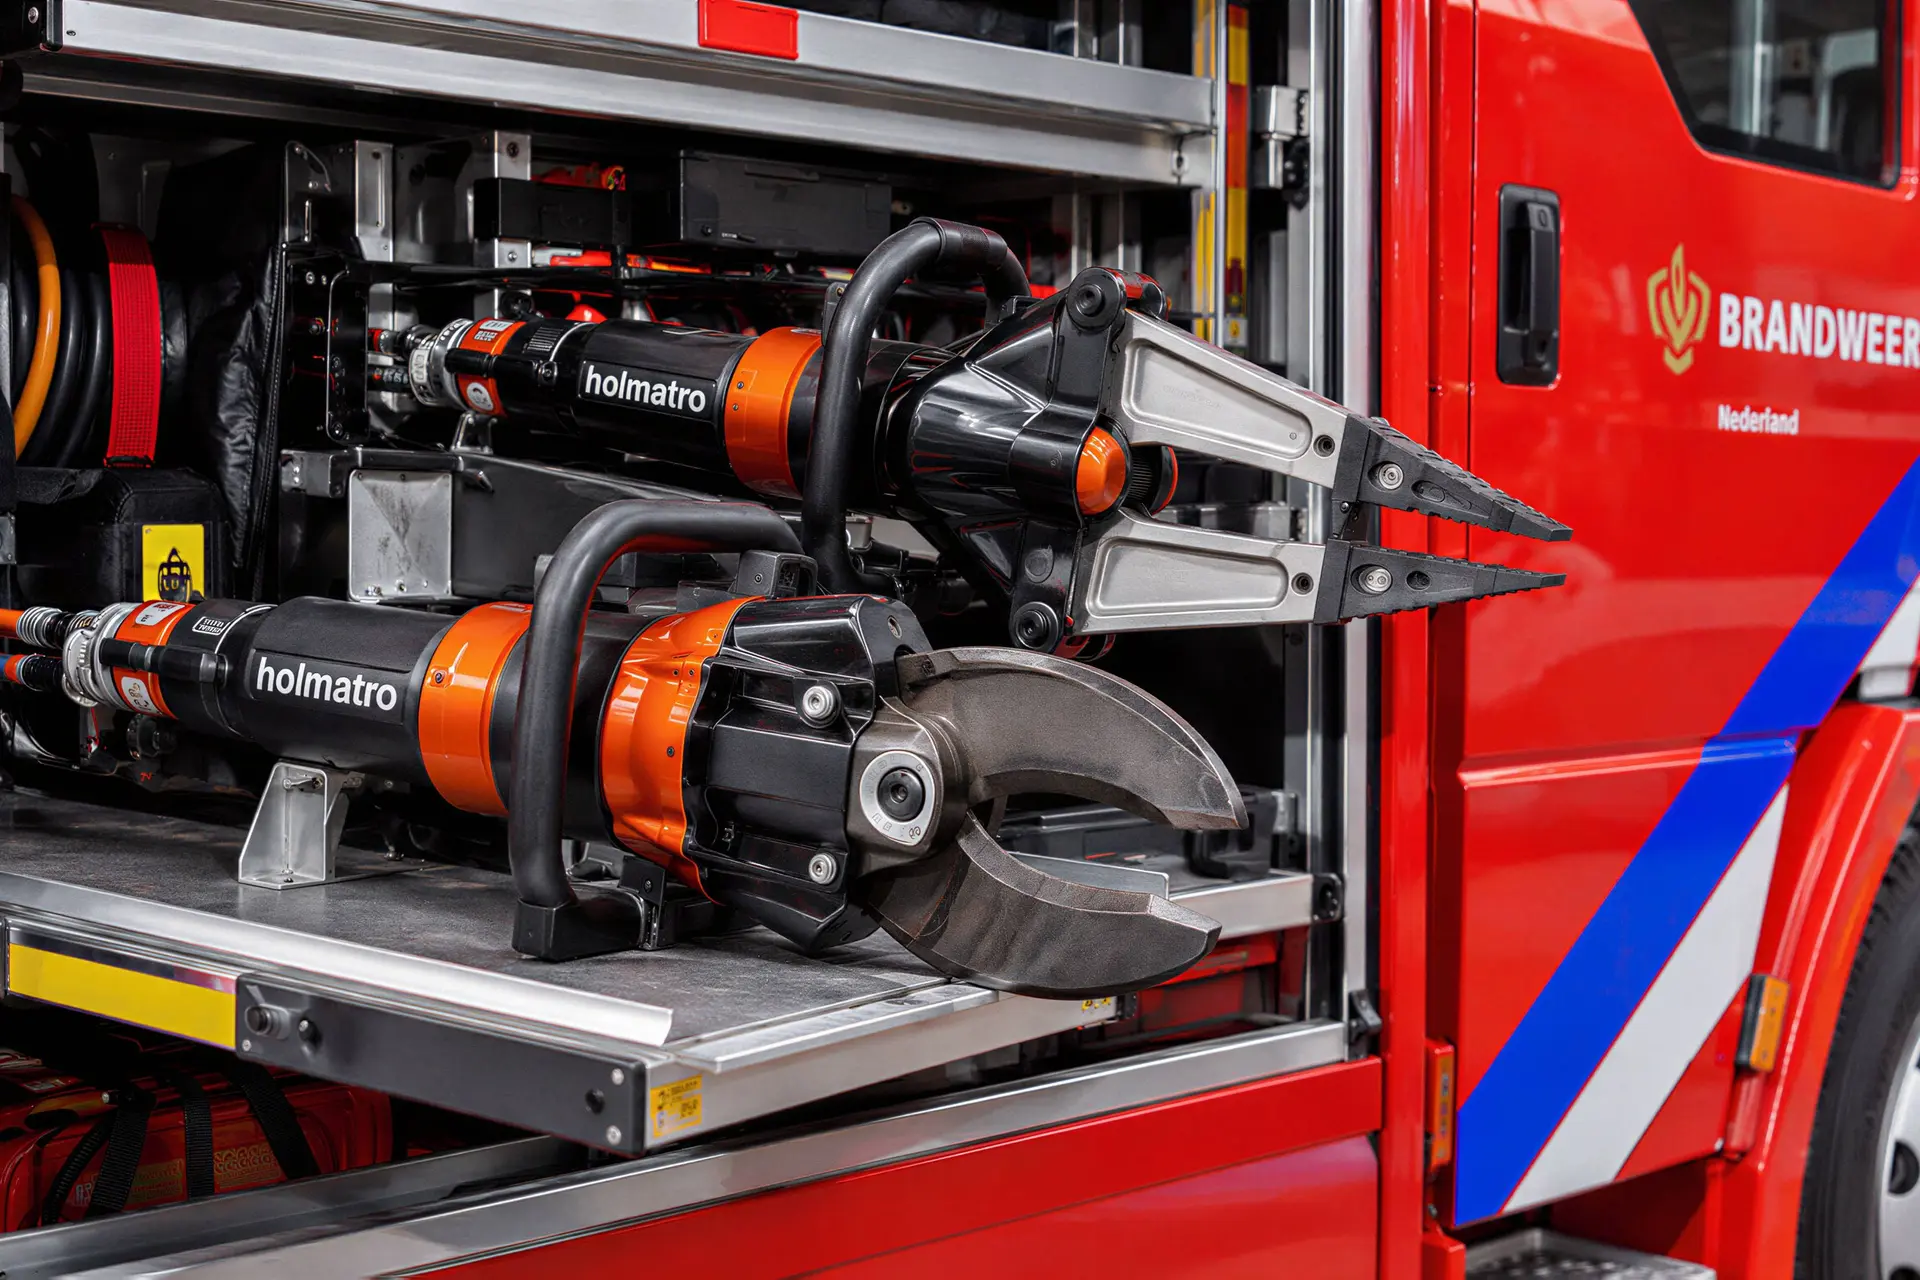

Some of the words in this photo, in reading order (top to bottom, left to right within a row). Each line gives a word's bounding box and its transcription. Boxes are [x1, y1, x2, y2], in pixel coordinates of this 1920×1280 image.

[1719, 292, 1920, 369] BRANDWEER
[585, 365, 706, 412] holmatro
[1718, 404, 1799, 435] Nederland
[256, 656, 398, 711] holmatro
